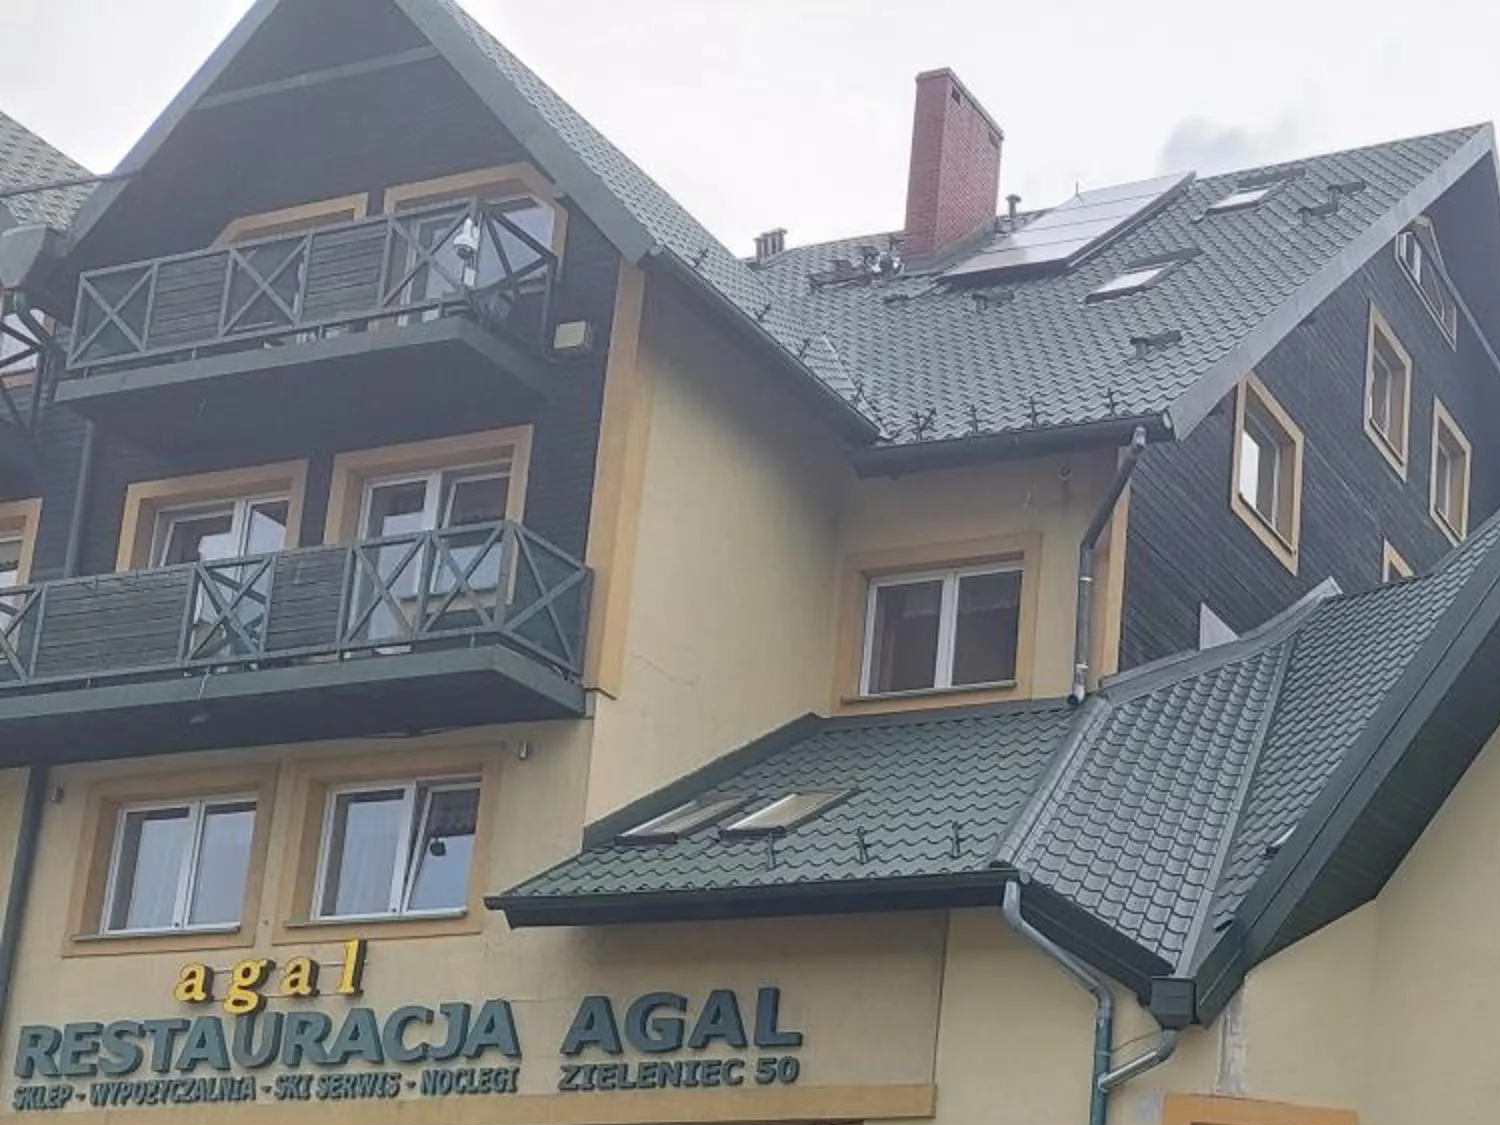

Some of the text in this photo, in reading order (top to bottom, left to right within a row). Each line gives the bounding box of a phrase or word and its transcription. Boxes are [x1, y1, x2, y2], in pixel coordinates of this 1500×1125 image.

[174, 938, 367, 1015] agal
[14, 986, 804, 1078] RESTAURACJA AGAL
[12, 1083, 73, 1111] SKLEP
[274, 1073, 314, 1102] SKI
[316, 1072, 402, 1099] SERWIS
[420, 1066, 520, 1095] NOCLEGI
[558, 1055, 801, 1091] ZIELENIEC 50
